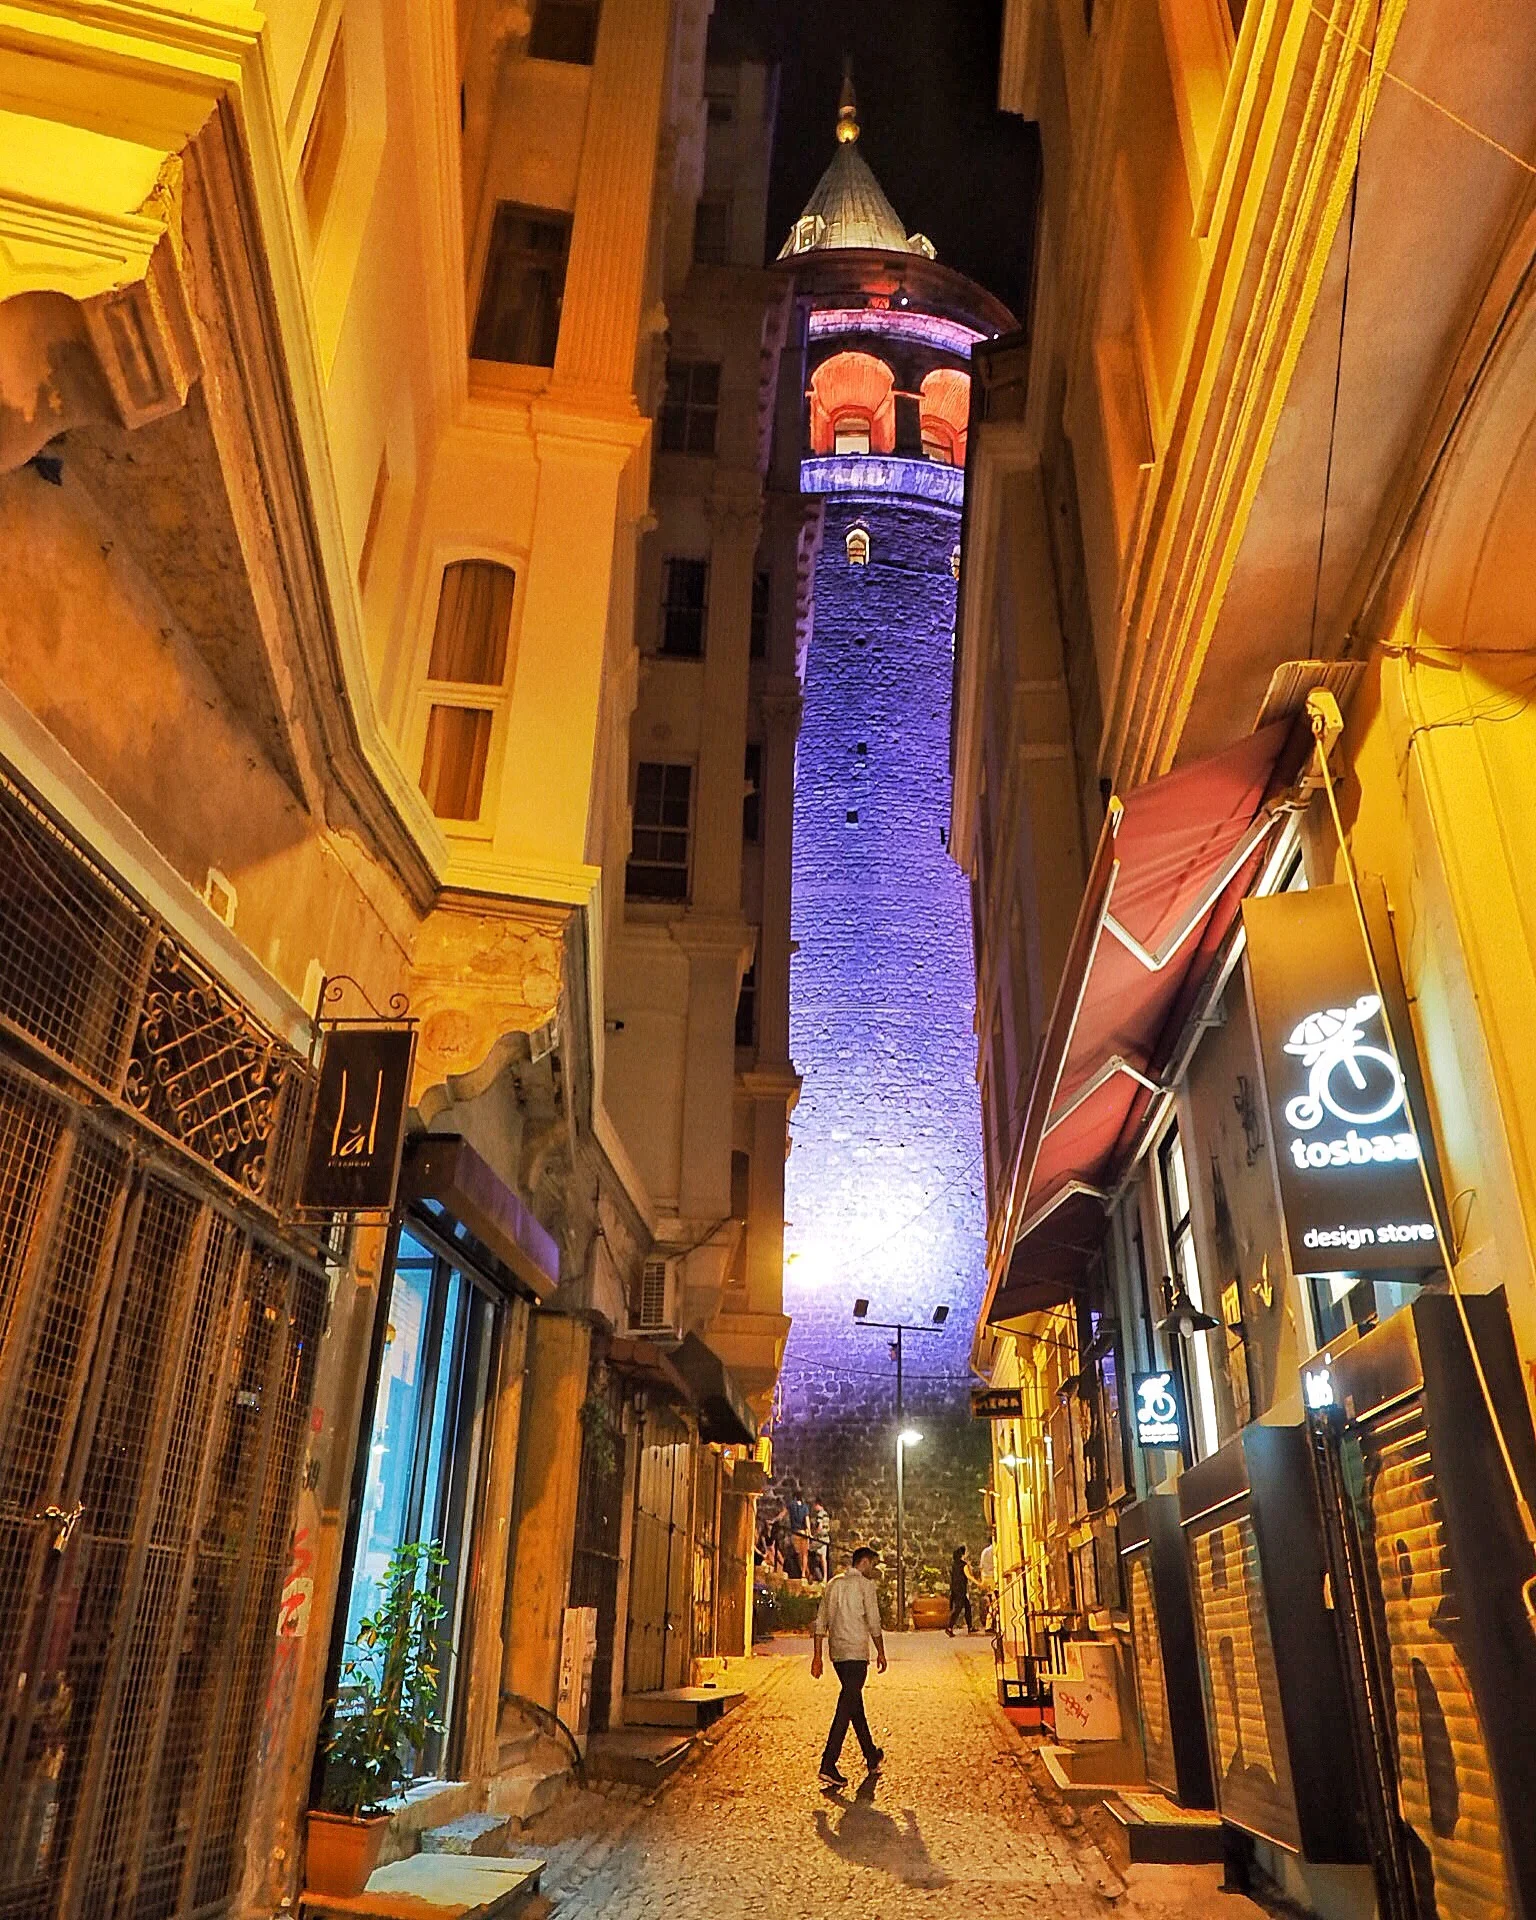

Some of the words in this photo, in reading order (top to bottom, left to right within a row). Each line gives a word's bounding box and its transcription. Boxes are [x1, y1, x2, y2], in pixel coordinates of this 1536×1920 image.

[1290, 1129, 1420, 1169] tosbaa
[1303, 1225, 1375, 1250] design
[1376, 1223, 1435, 1243] store
